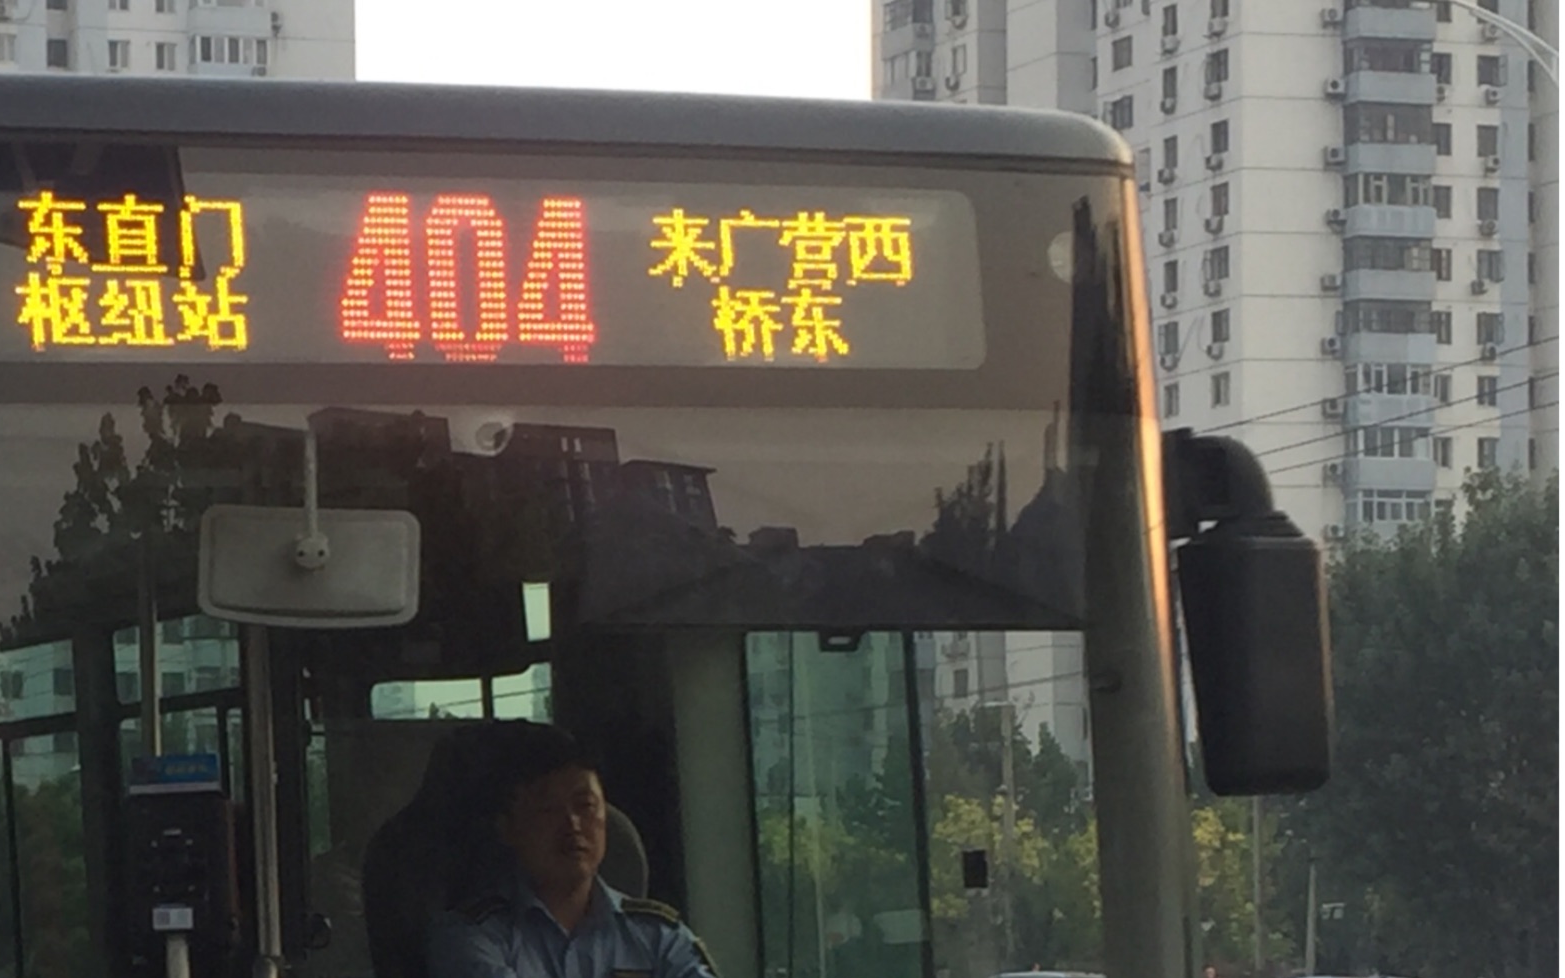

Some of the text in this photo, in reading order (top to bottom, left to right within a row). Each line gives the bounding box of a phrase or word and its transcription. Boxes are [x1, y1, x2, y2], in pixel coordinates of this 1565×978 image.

[18, 191, 244, 277] 东直门
[648, 208, 912, 290] 来广营西
[15, 272, 248, 350] 枢纽站
[339, 193, 597, 362] 404
[711, 285, 849, 362] 桥东
